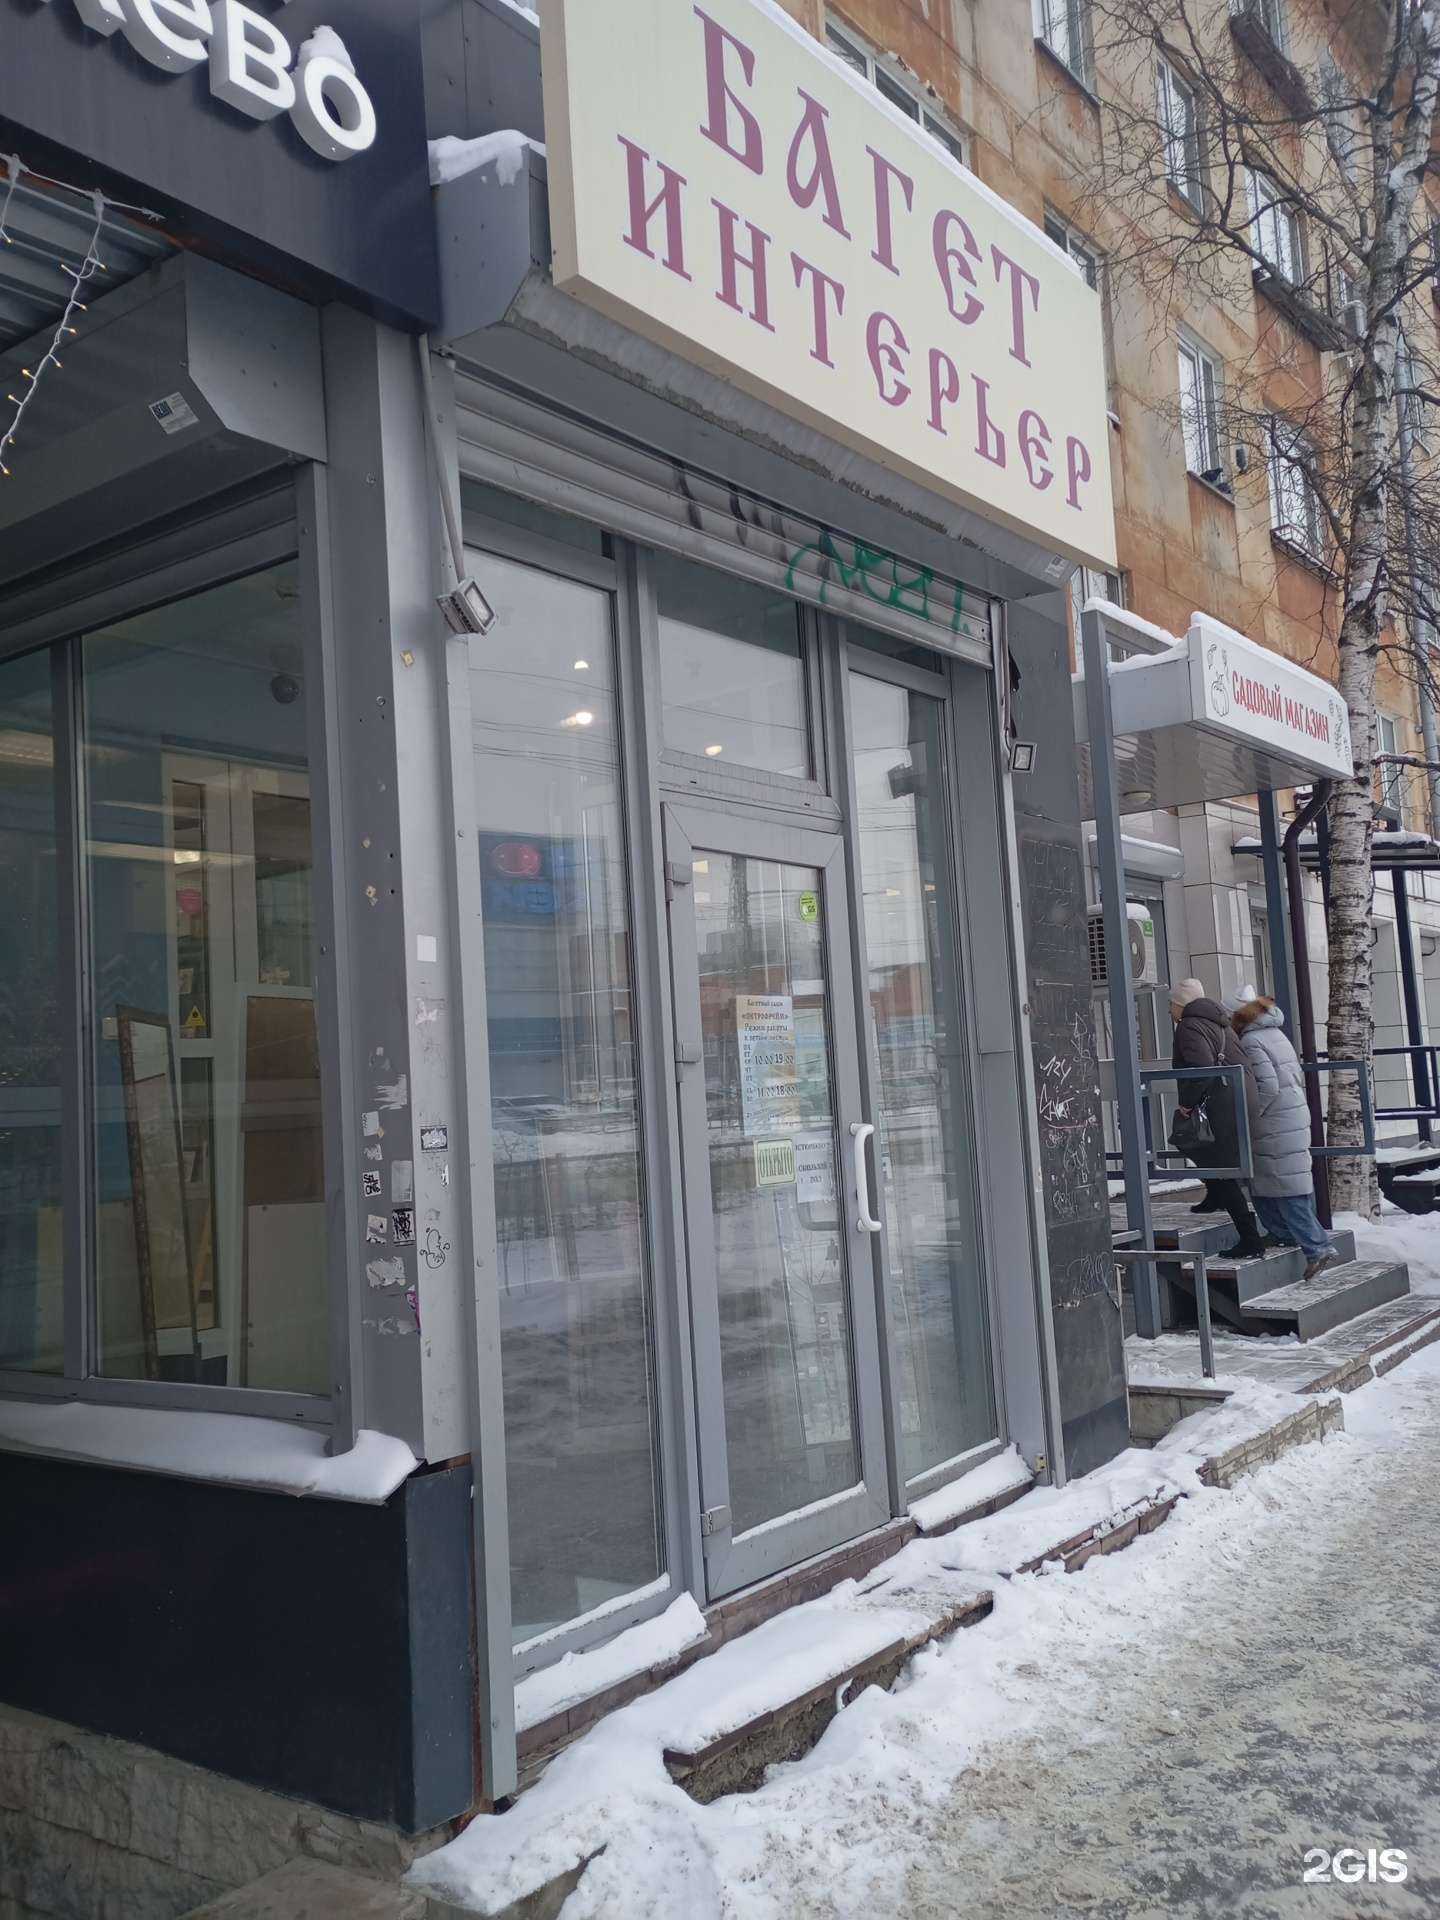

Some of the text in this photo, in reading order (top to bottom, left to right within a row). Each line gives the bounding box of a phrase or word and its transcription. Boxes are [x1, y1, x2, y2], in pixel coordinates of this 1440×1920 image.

[693, 4, 1041, 368] БАГЕТ
[616, 134, 1092, 511] ИНТЕРЬЕР
[1232, 670, 1330, 744] САДОВЫЙ МАГАЗИН
[759, 1145, 793, 1178] ОТКРЫТО
